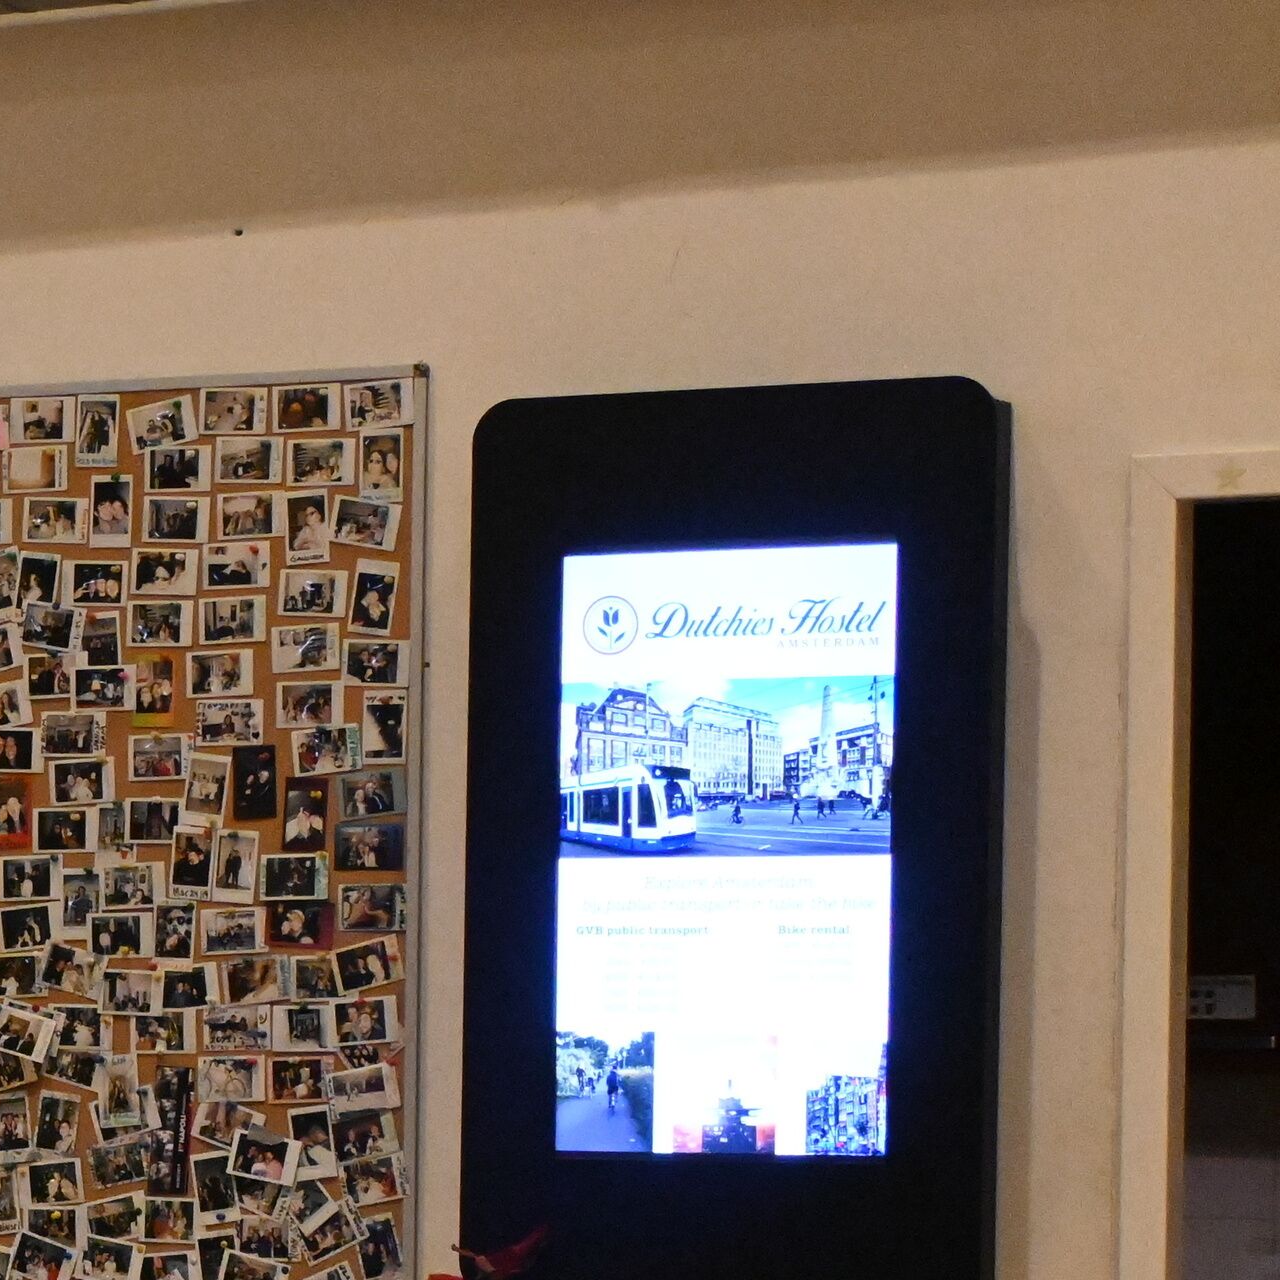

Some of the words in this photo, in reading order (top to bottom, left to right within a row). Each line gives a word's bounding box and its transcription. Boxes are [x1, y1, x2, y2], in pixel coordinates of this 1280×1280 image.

[645, 602, 776, 639] Dutchies
[780, 597, 886, 636] Hostel
[777, 637, 880, 649] AMSTERDAM
[576, 926, 603, 935] GVB
[607, 925, 645, 937] public
[648, 926, 709, 937] transport
[778, 925, 807, 935] Bike
[811, 925, 850, 935] rental
[178, 1114, 186, 1144] NAPOLI
